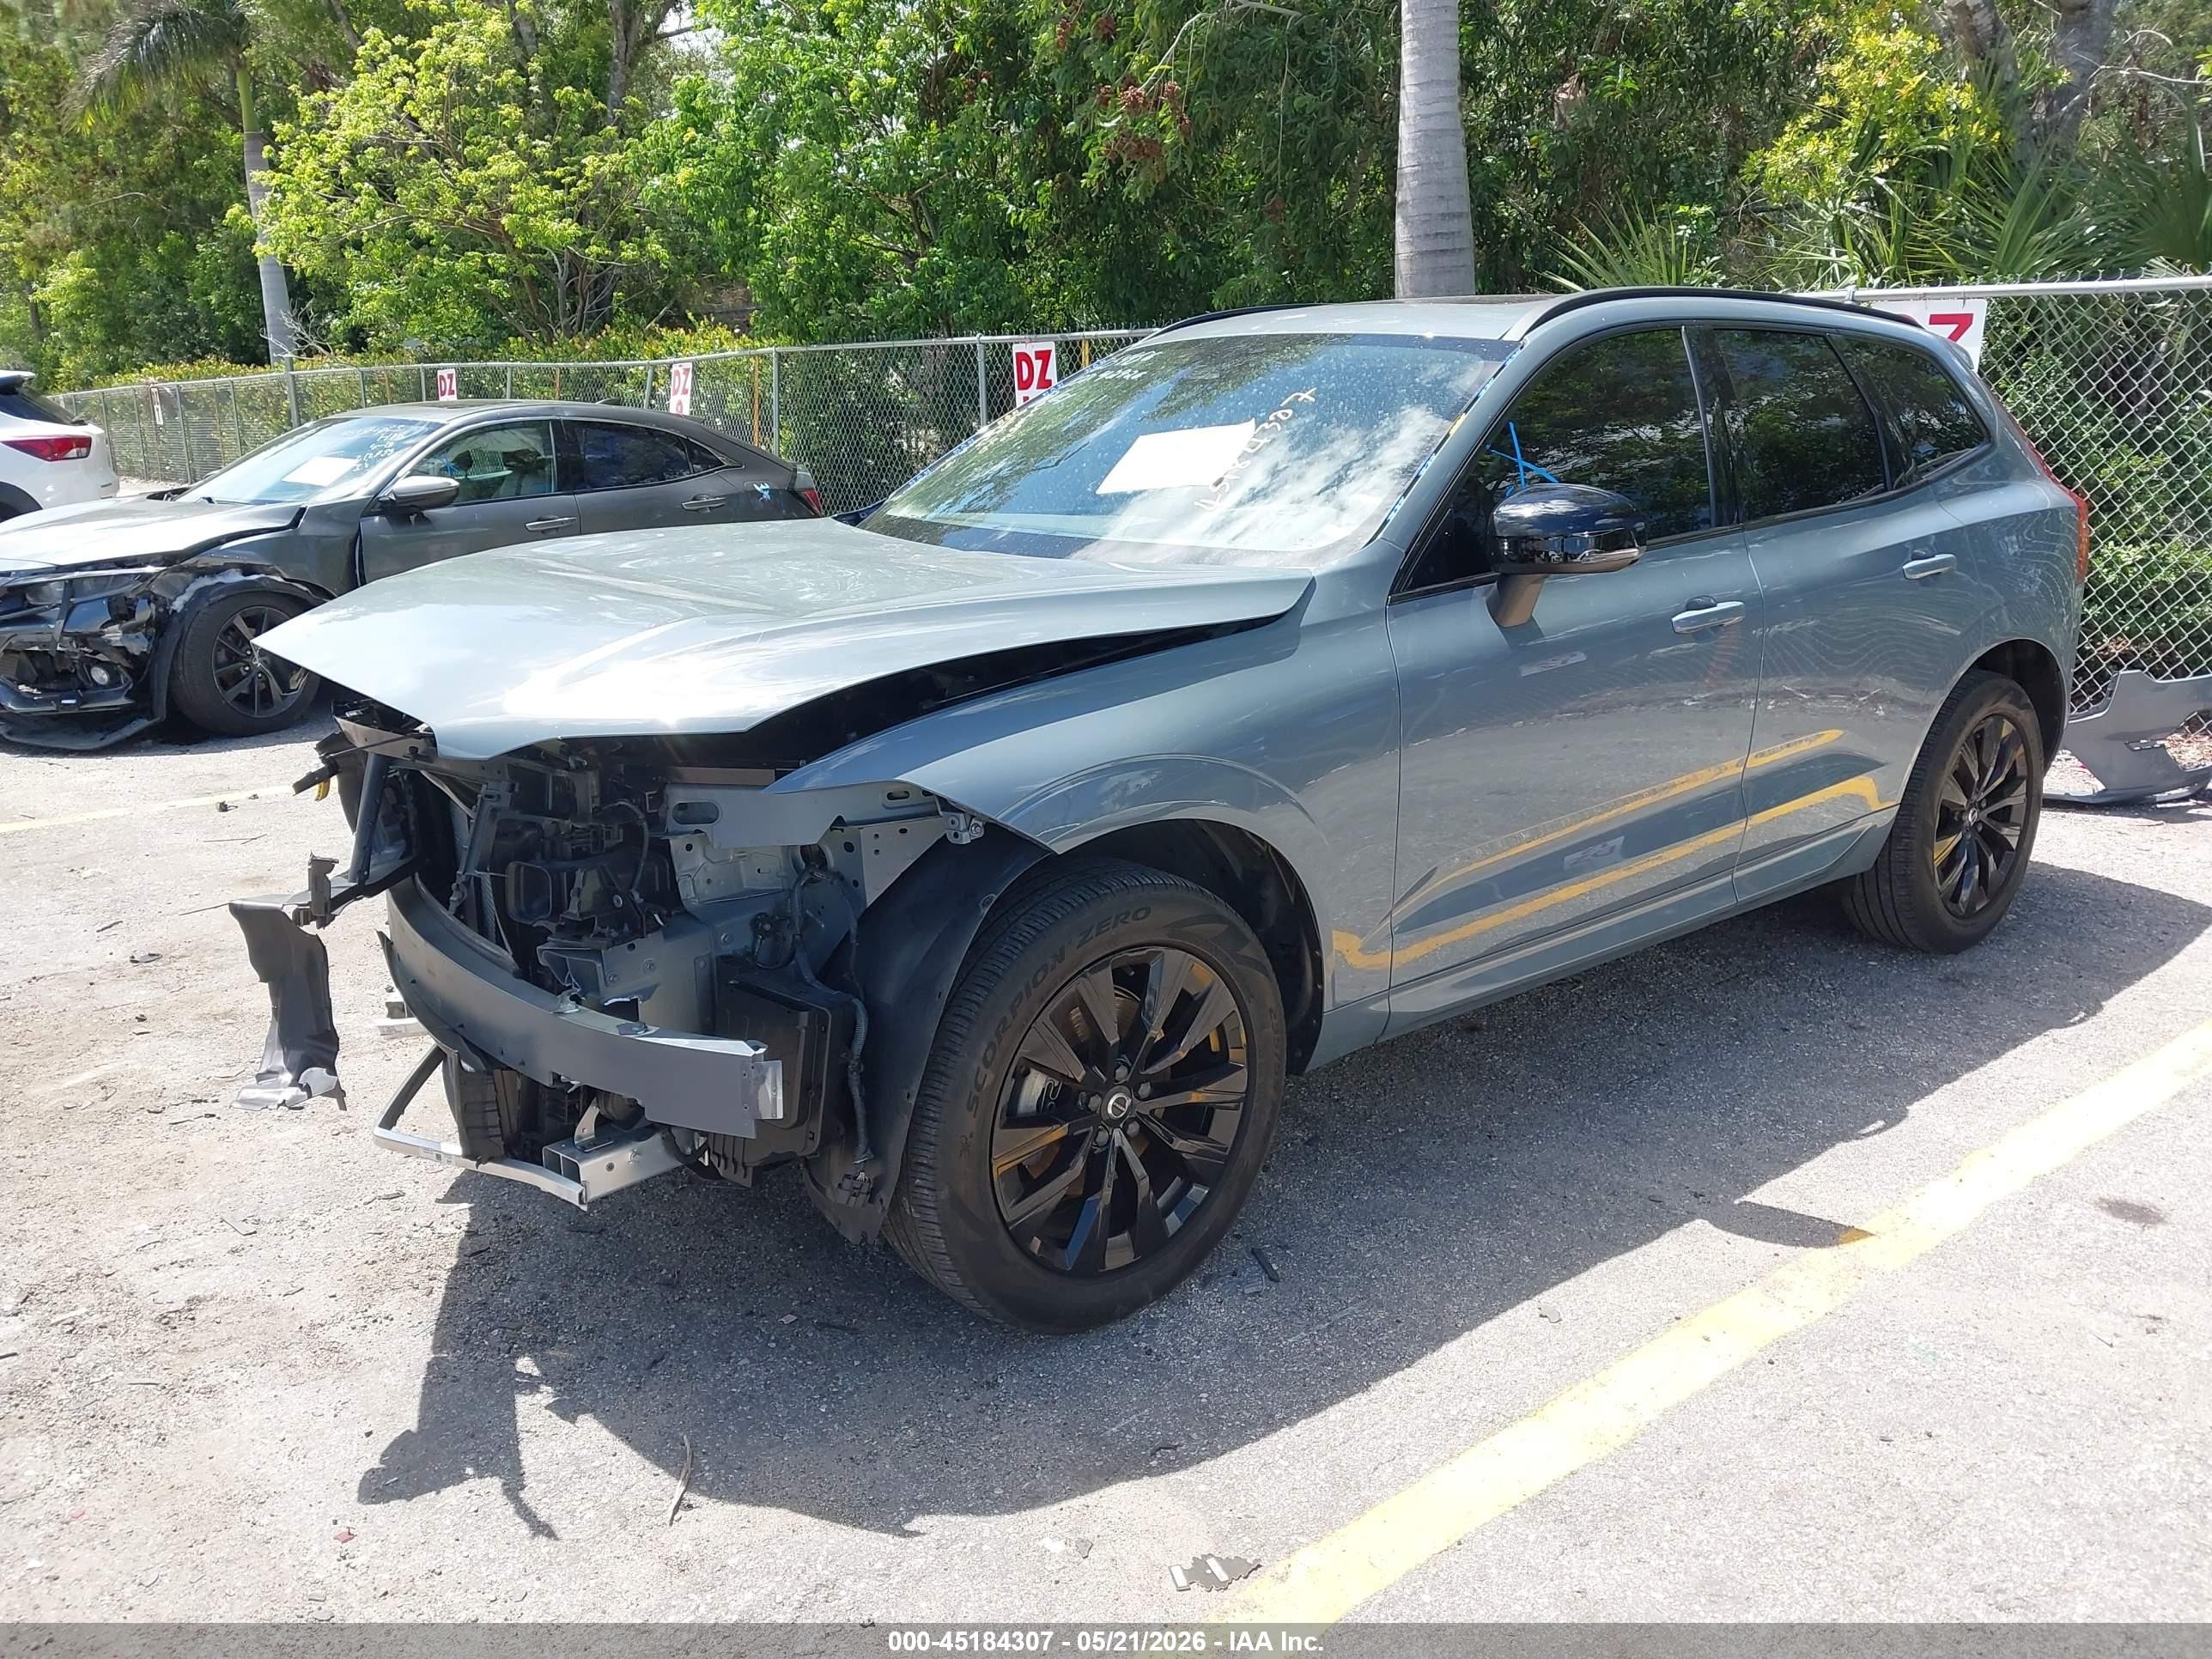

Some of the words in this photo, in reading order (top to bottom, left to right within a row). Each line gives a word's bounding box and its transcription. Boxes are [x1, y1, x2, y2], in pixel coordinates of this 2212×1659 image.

[438, 373, 455, 397] DZ
[672, 368, 691, 396] DZ
[1015, 349, 1053, 391] DZ
[966, 945, 1066, 1119] SCORPION
[1075, 906, 1152, 950] ZERO
